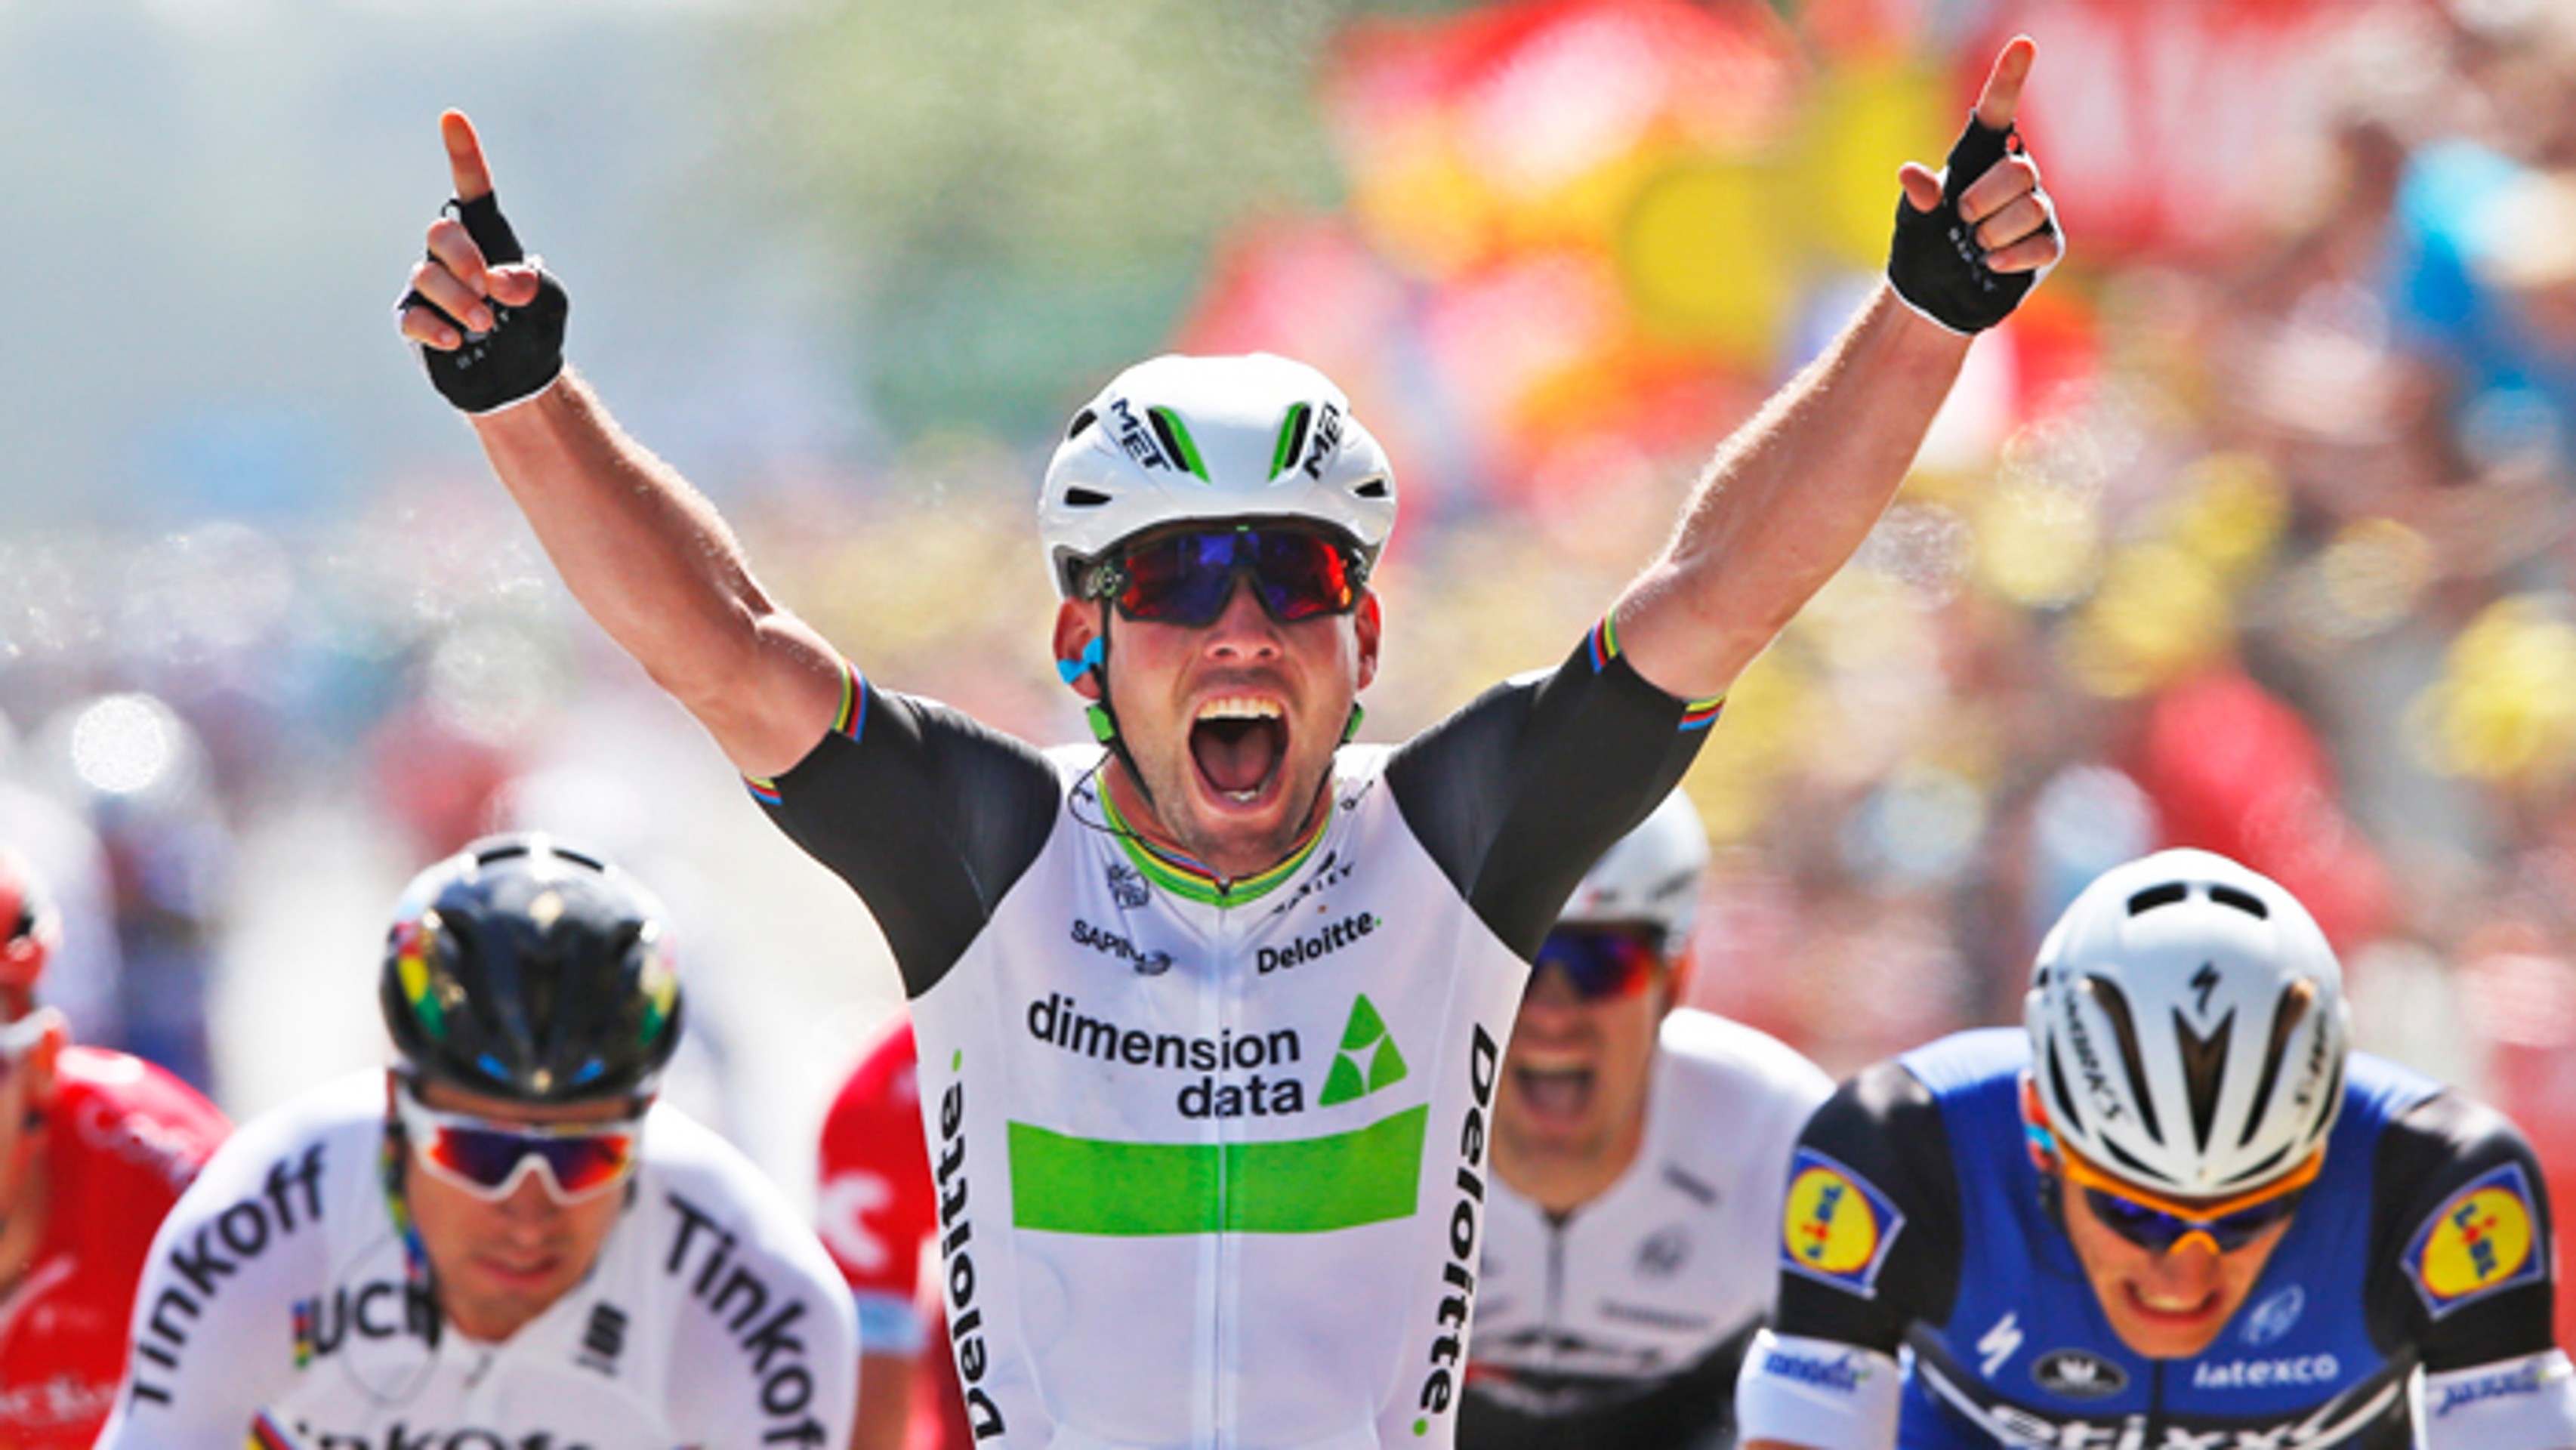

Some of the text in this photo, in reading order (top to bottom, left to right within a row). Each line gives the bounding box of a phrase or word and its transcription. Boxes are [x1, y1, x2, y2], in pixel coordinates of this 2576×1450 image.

[1111, 398, 1172, 473] MET
[1028, 993, 1300, 1071] dimension
[1177, 1074, 1304, 1119] data
